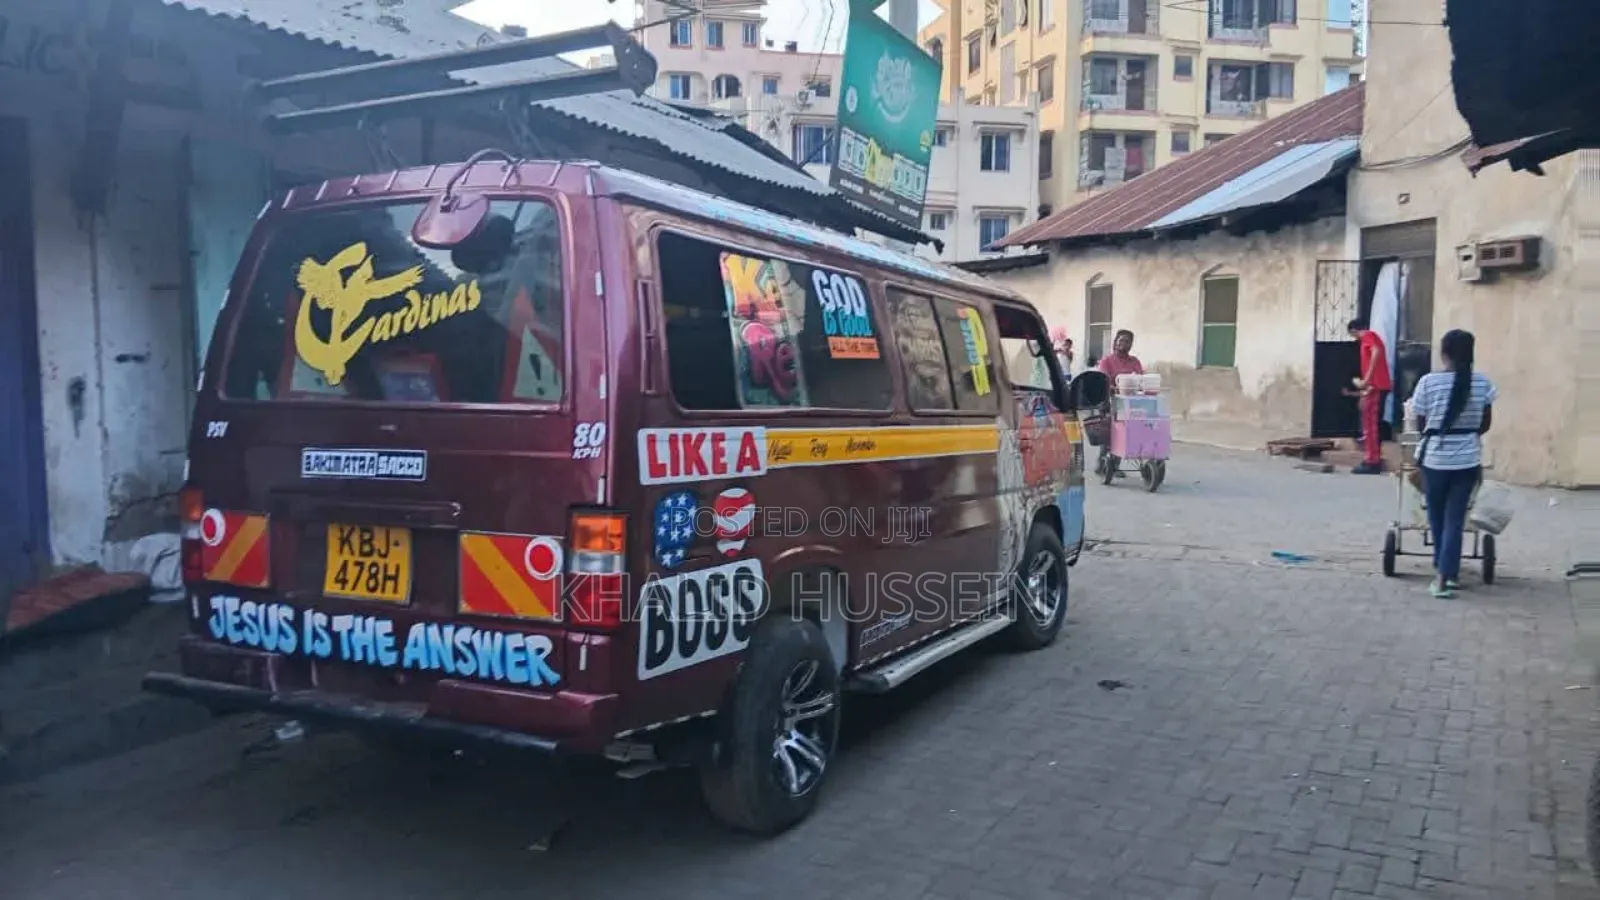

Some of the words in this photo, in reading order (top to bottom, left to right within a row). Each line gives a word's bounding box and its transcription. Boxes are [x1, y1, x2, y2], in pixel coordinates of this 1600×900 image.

[812, 270, 868, 317] GOD
[207, 421, 229, 437] PSV
[574, 422, 606, 447] 80
[378, 455, 424, 476] SACCO
[572, 447, 601, 459] KPH
[646, 432, 728, 479] LIKE
[736, 431, 761, 473] A
[334, 560, 400, 594] 478H
[645, 566, 756, 670] BOSS
[209, 595, 298, 655] JESUS
[303, 609, 333, 658] IS
[332, 614, 398, 667] THE
[403, 623, 562, 687] ANSWER
